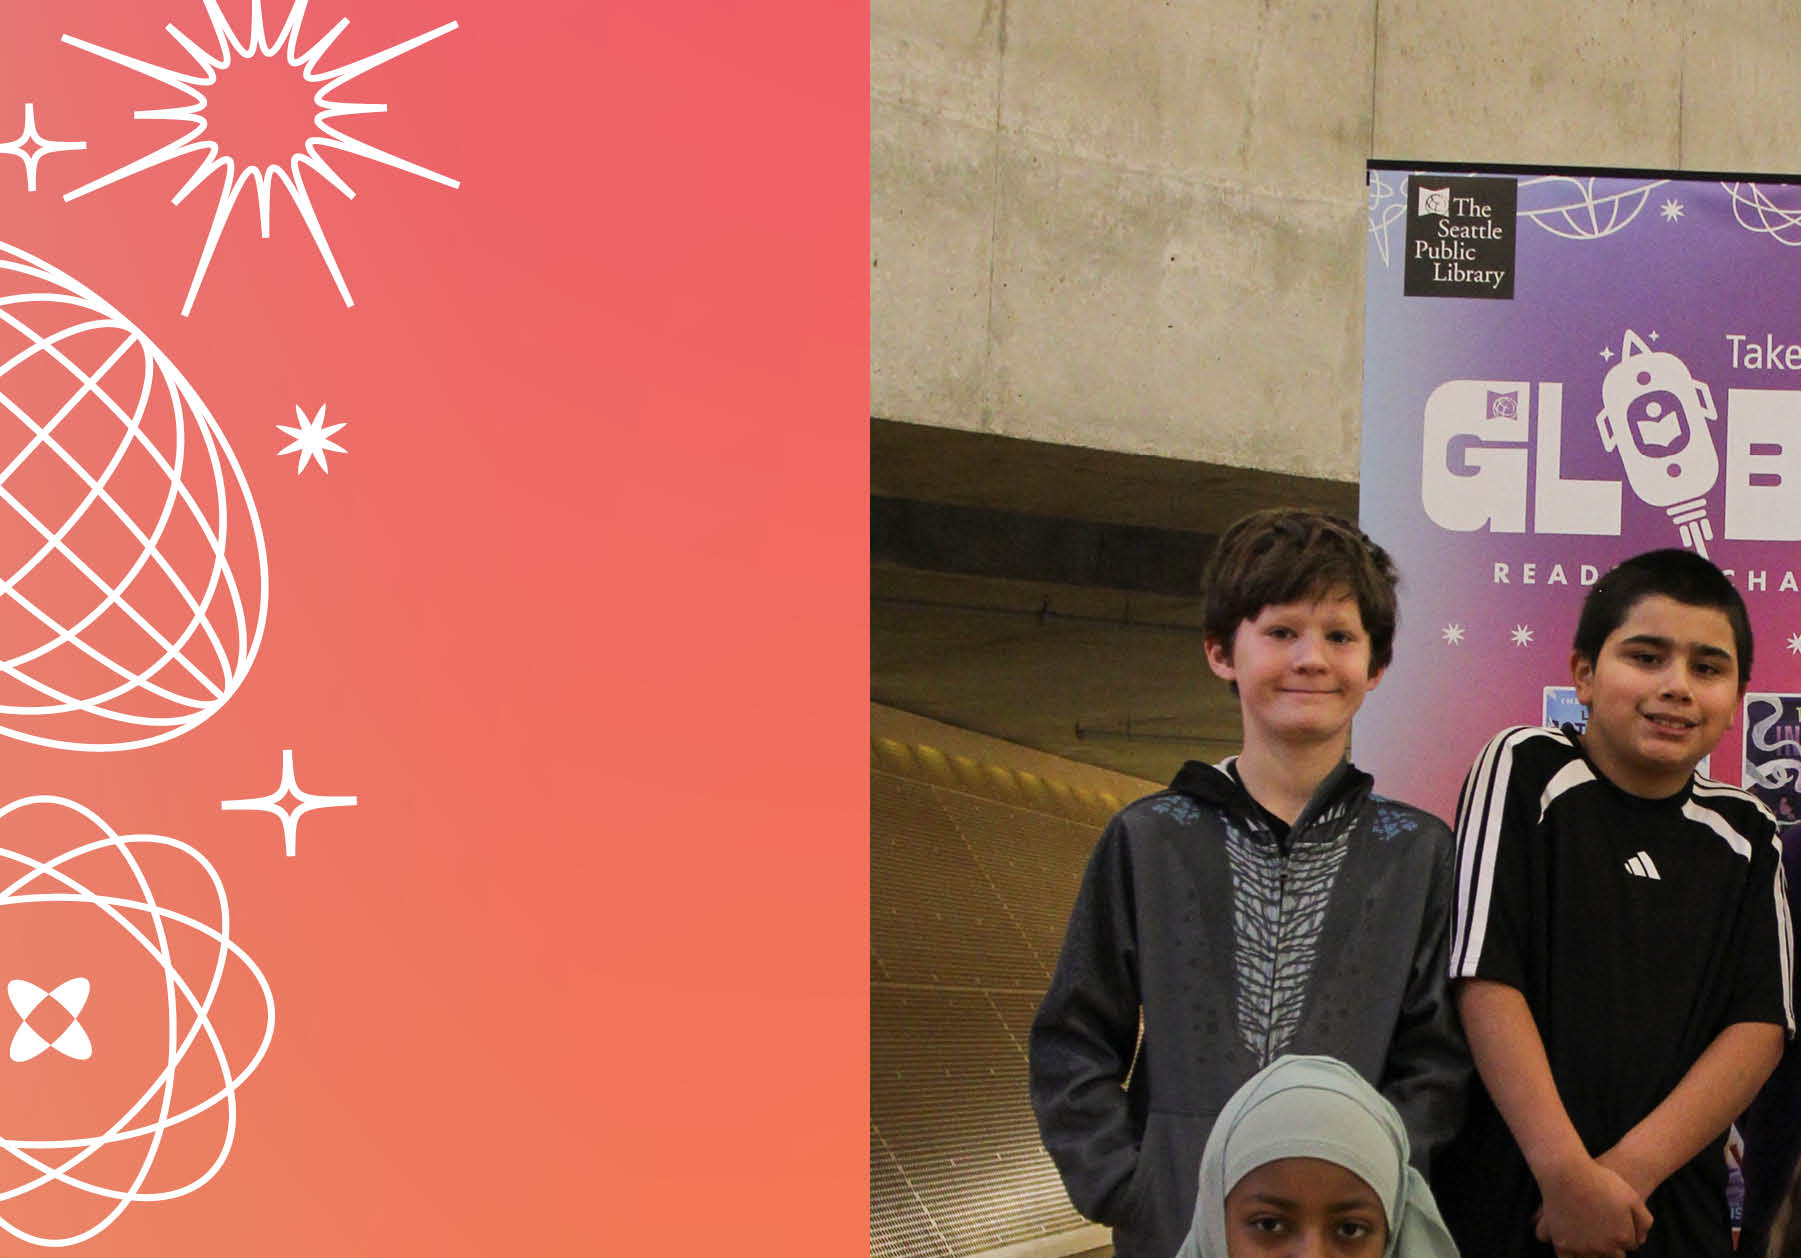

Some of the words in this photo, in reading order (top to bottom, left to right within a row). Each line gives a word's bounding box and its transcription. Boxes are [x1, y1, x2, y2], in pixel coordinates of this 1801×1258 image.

[1453, 198, 1492, 217] The
[1437, 218, 1503, 240] Seattle
[1415, 240, 1476, 260] Public
[1433, 262, 1505, 289] Library
[1494, 563, 1600, 586] READ
